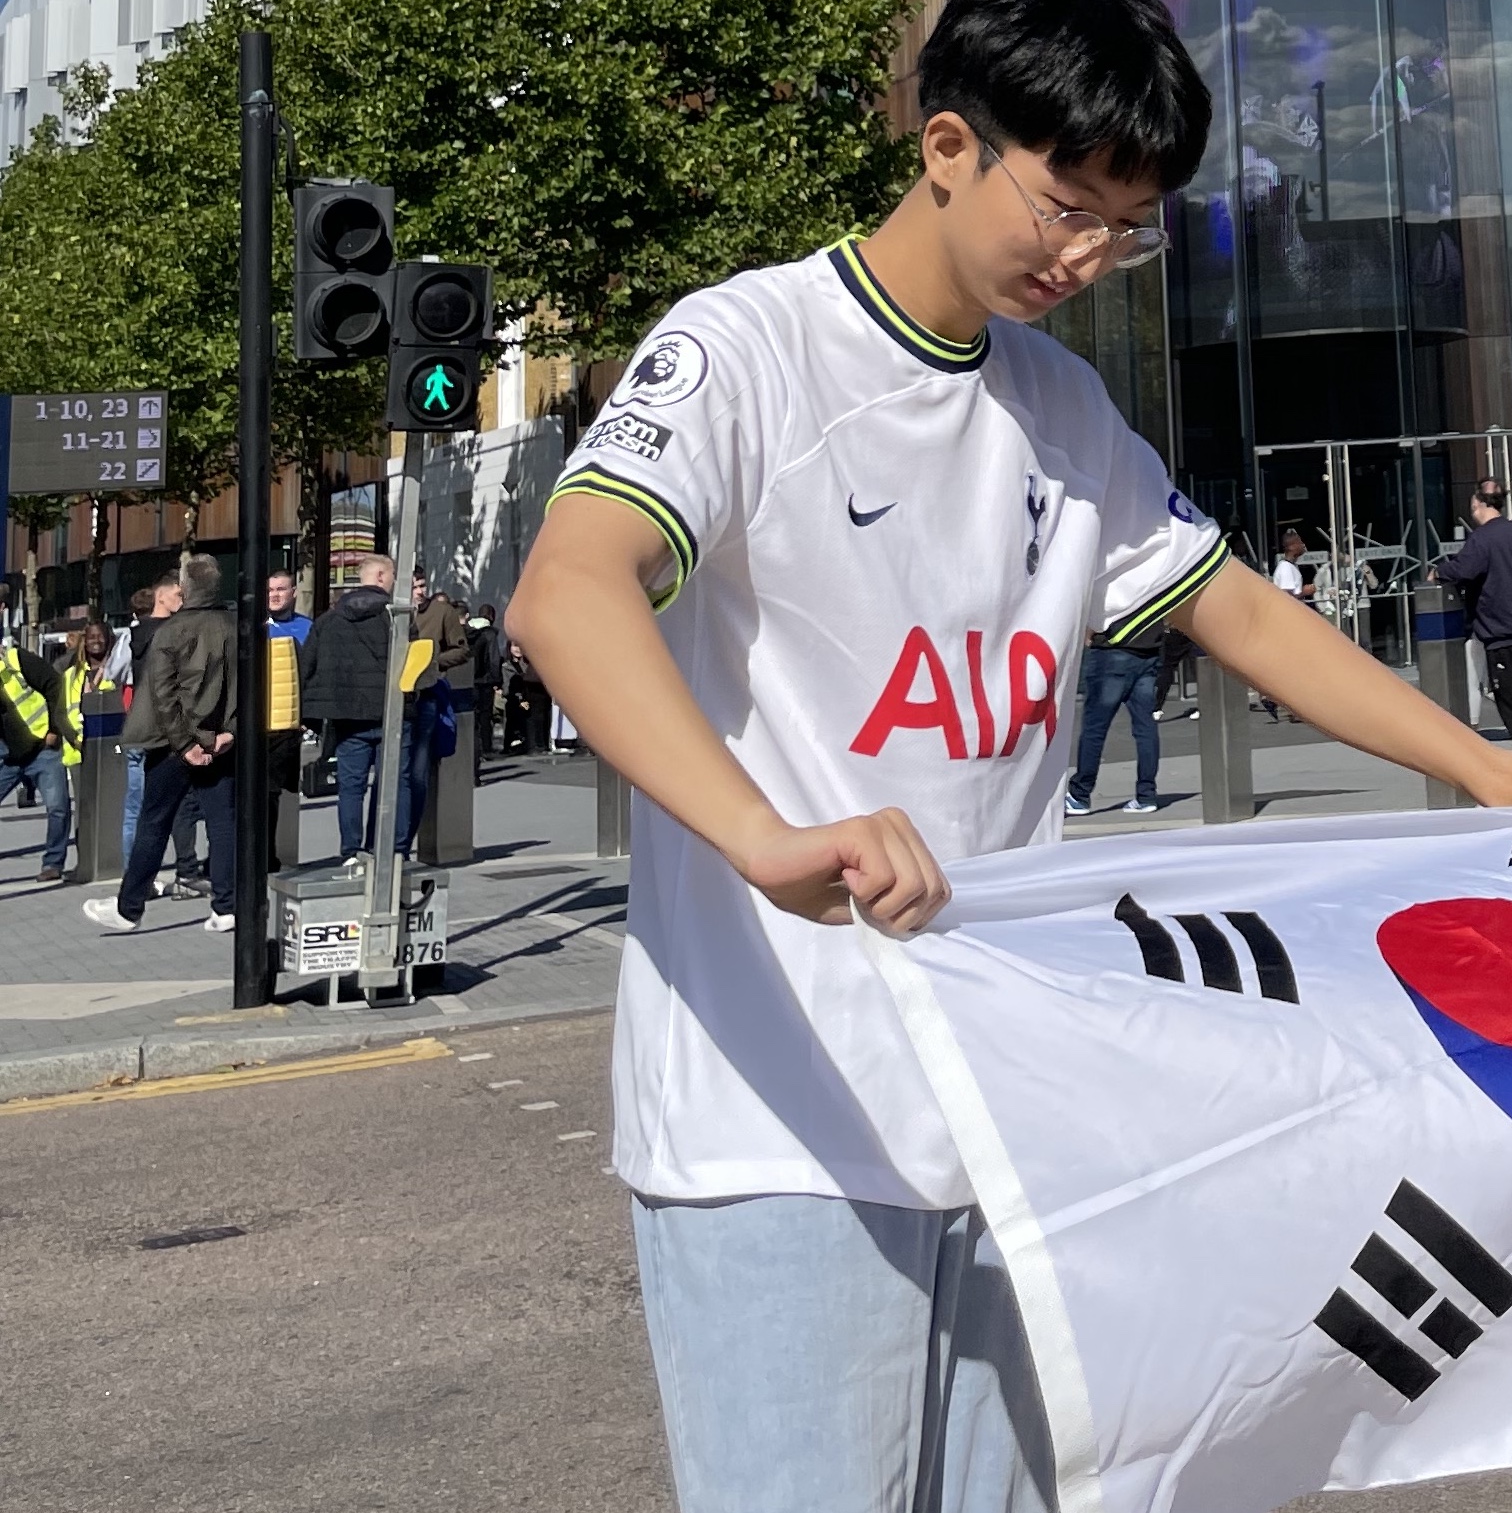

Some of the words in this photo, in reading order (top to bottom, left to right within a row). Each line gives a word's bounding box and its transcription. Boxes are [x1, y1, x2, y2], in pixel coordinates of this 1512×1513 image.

[101, 398, 128, 418] 23
[62, 430, 127, 450] 11-21
[602, 416, 659, 444] room
[592, 430, 660, 460] racism
[99, 461, 126, 480] 22
[848, 625, 1057, 760] AIA
[405, 911, 434, 933] EM
[304, 924, 360, 944] SRL
[396, 941, 444, 964] 876
